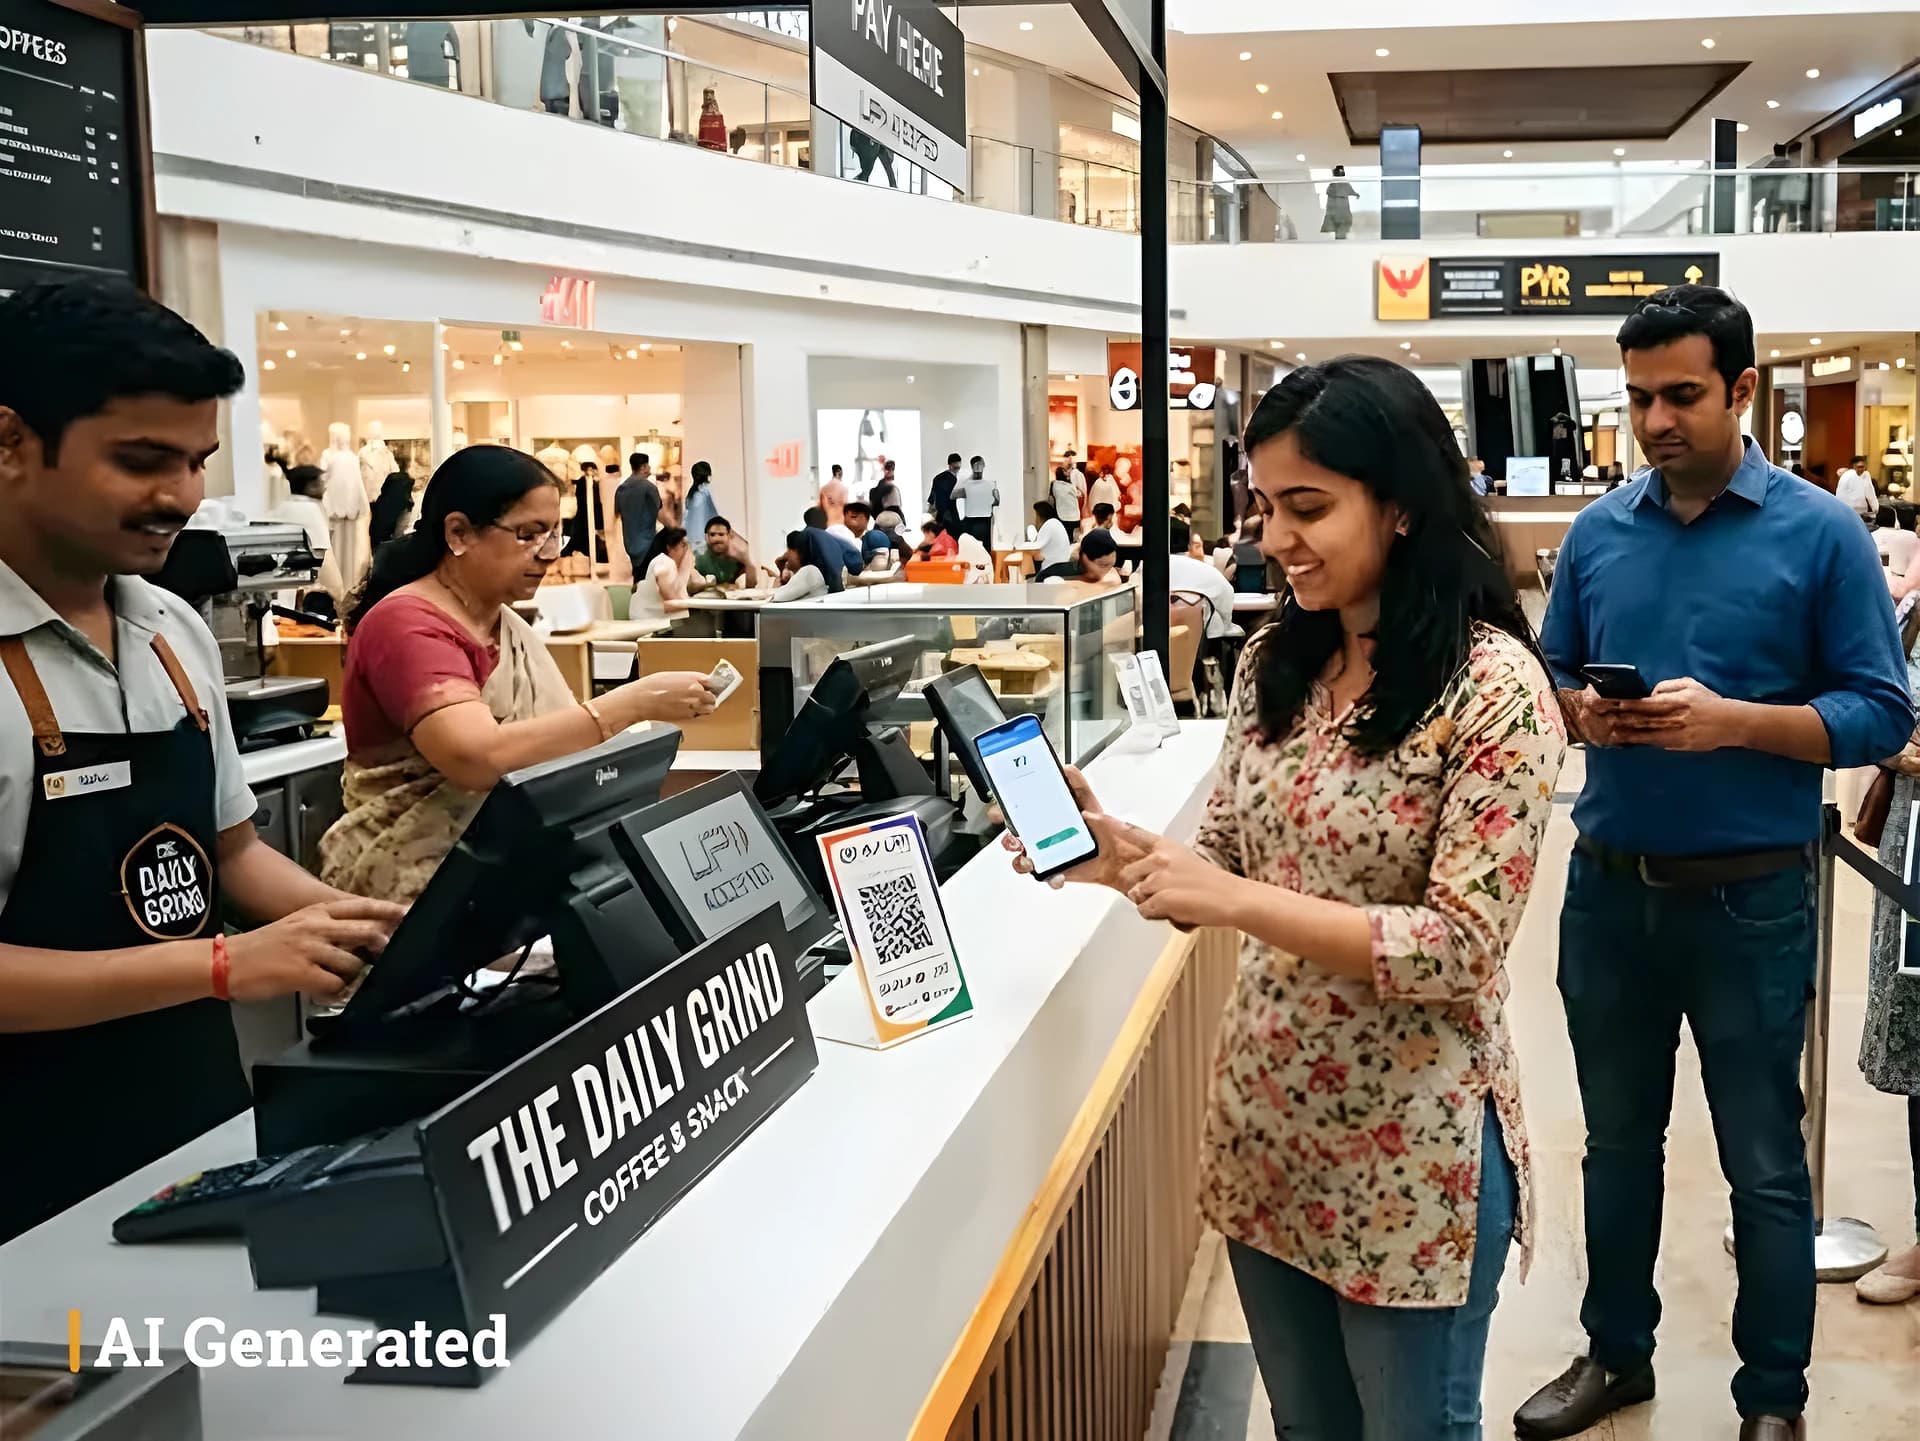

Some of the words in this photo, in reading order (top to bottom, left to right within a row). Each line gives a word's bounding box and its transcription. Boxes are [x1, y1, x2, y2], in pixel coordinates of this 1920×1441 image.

[466, 1085, 579, 1234] THE
[571, 1006, 686, 1160] DAILY
[687, 942, 784, 1069] GRIND
[584, 1134, 671, 1226] COFFEE
[687, 1066, 750, 1139] SNACK
